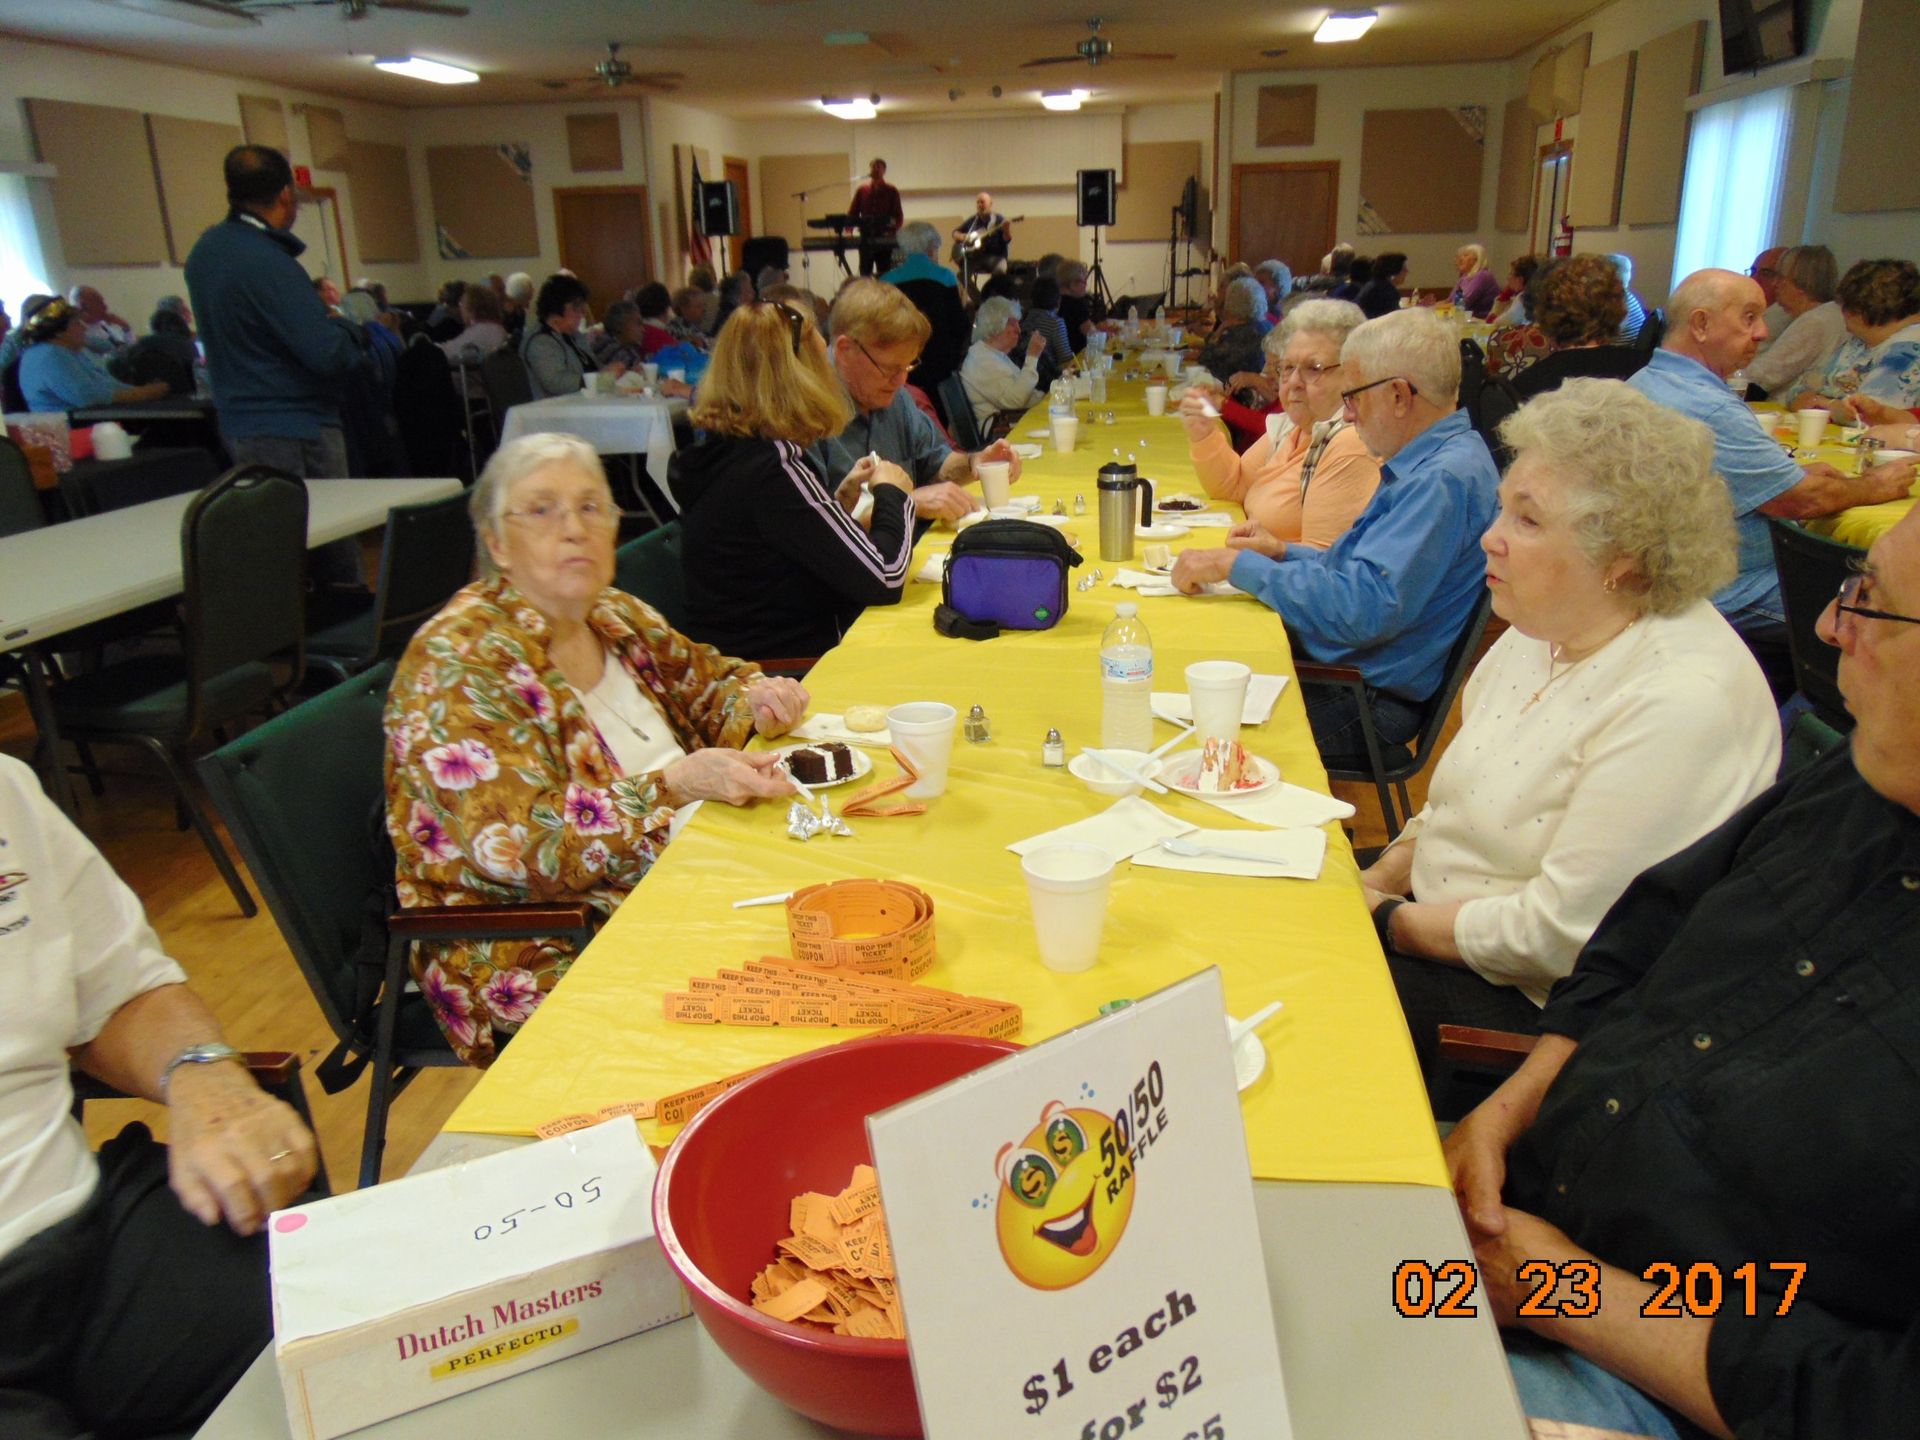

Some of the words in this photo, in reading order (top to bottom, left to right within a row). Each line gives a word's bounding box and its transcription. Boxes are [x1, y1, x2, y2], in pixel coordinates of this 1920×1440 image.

[855, 944, 876, 952] DROP
[877, 942, 892, 950] THIS
[798, 949, 824, 961] COUPON
[862, 949, 886, 958] TICKET
[747, 964, 762, 974] KEEP
[764, 967, 778, 976] THIS
[722, 973, 739, 981] KEEP
[692, 981, 710, 990] KEEP
[711, 983, 727, 991] THIS
[746, 987, 764, 996] KEEP
[765, 988, 781, 996] THIS
[682, 1004, 706, 1012] TICKET
[675, 1011, 692, 1019] THIS
[988, 1015, 1019, 1035] COUPON
[664, 1097, 686, 1109] KEEP
[687, 1091, 705, 1102] THIS
[1099, 1060, 1164, 1178] 50/50
[546, 1119, 589, 1137] COUPON
[1106, 1107, 1169, 1204] RAFFLE
[854, 1202, 876, 1214] THIS
[396, 1313, 485, 1361] Dutch
[492, 1280, 603, 1330] Masters
[449, 1325, 563, 1372] PERFECTO
[1022, 1358, 1074, 1415] $1
[1088, 1290, 1197, 1374] each
[1155, 1355, 1203, 1409] $2
